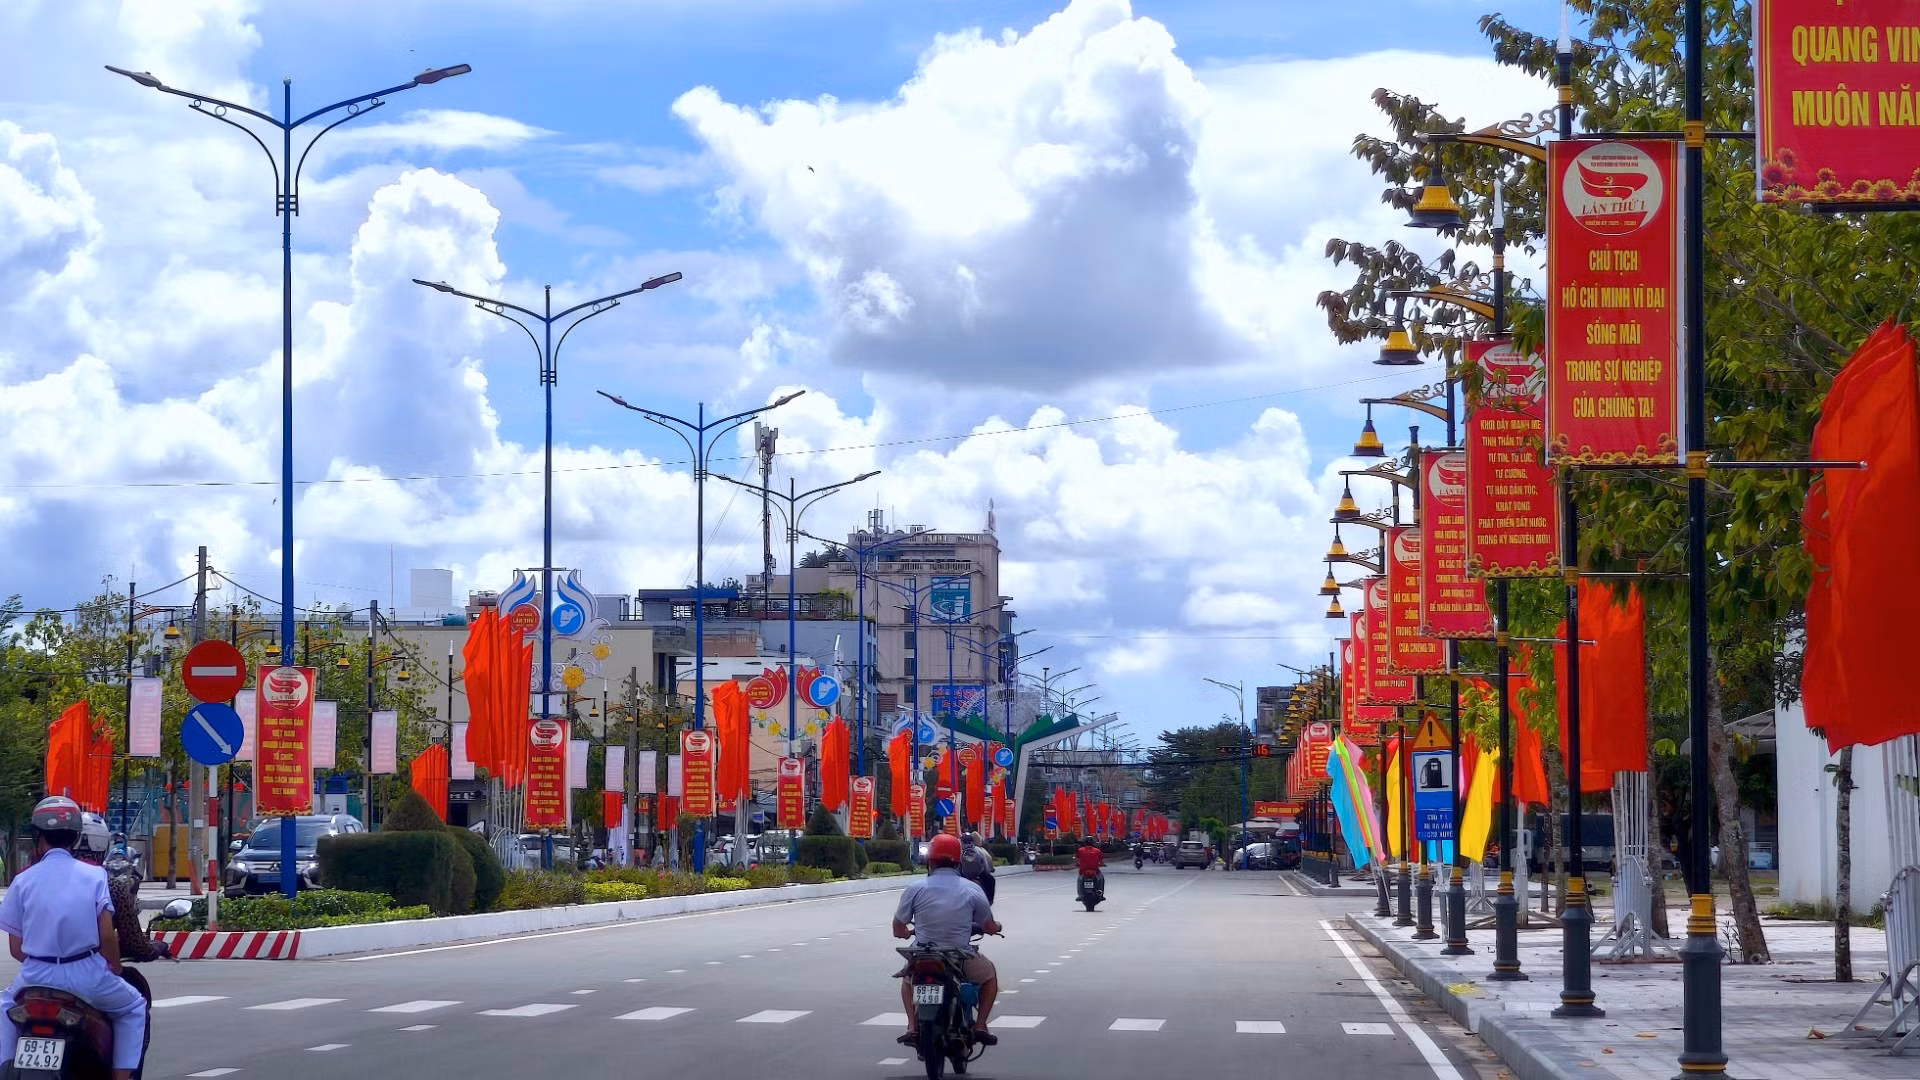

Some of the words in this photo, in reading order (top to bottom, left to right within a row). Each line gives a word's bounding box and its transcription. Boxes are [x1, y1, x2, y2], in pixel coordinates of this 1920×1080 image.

[1792, 25, 1878, 66] QUANG
[1792, 82, 1870, 126] MUÔN
[1878, 83, 1920, 126] NĂ
[1582, 202, 1606, 214] LẦN
[1612, 198, 1638, 212] THỨ
[1589, 243, 1610, 270] CHỦ
[1614, 250, 1638, 276] TỊCH
[1562, 280, 1576, 308] HỒ
[1580, 282, 1598, 308] CHÍ
[1601, 287, 1630, 308] MINH
[1646, 288, 1664, 312] ĐẠI
[1586, 316, 1616, 344] SỐNG
[1620, 320, 1641, 344] MÃI
[1565, 360, 1601, 382] TRONG
[1604, 358, 1620, 386] SỰ
[1622, 356, 1662, 386] NGHIỆP
[1573, 390, 1595, 418] CỦA
[1598, 392, 1635, 418] CHÚNG
[1638, 397, 1654, 418] TA!
[18, 1054, 59, 1068] 424.92
[24, 1040, 56, 1054] 69-E1
